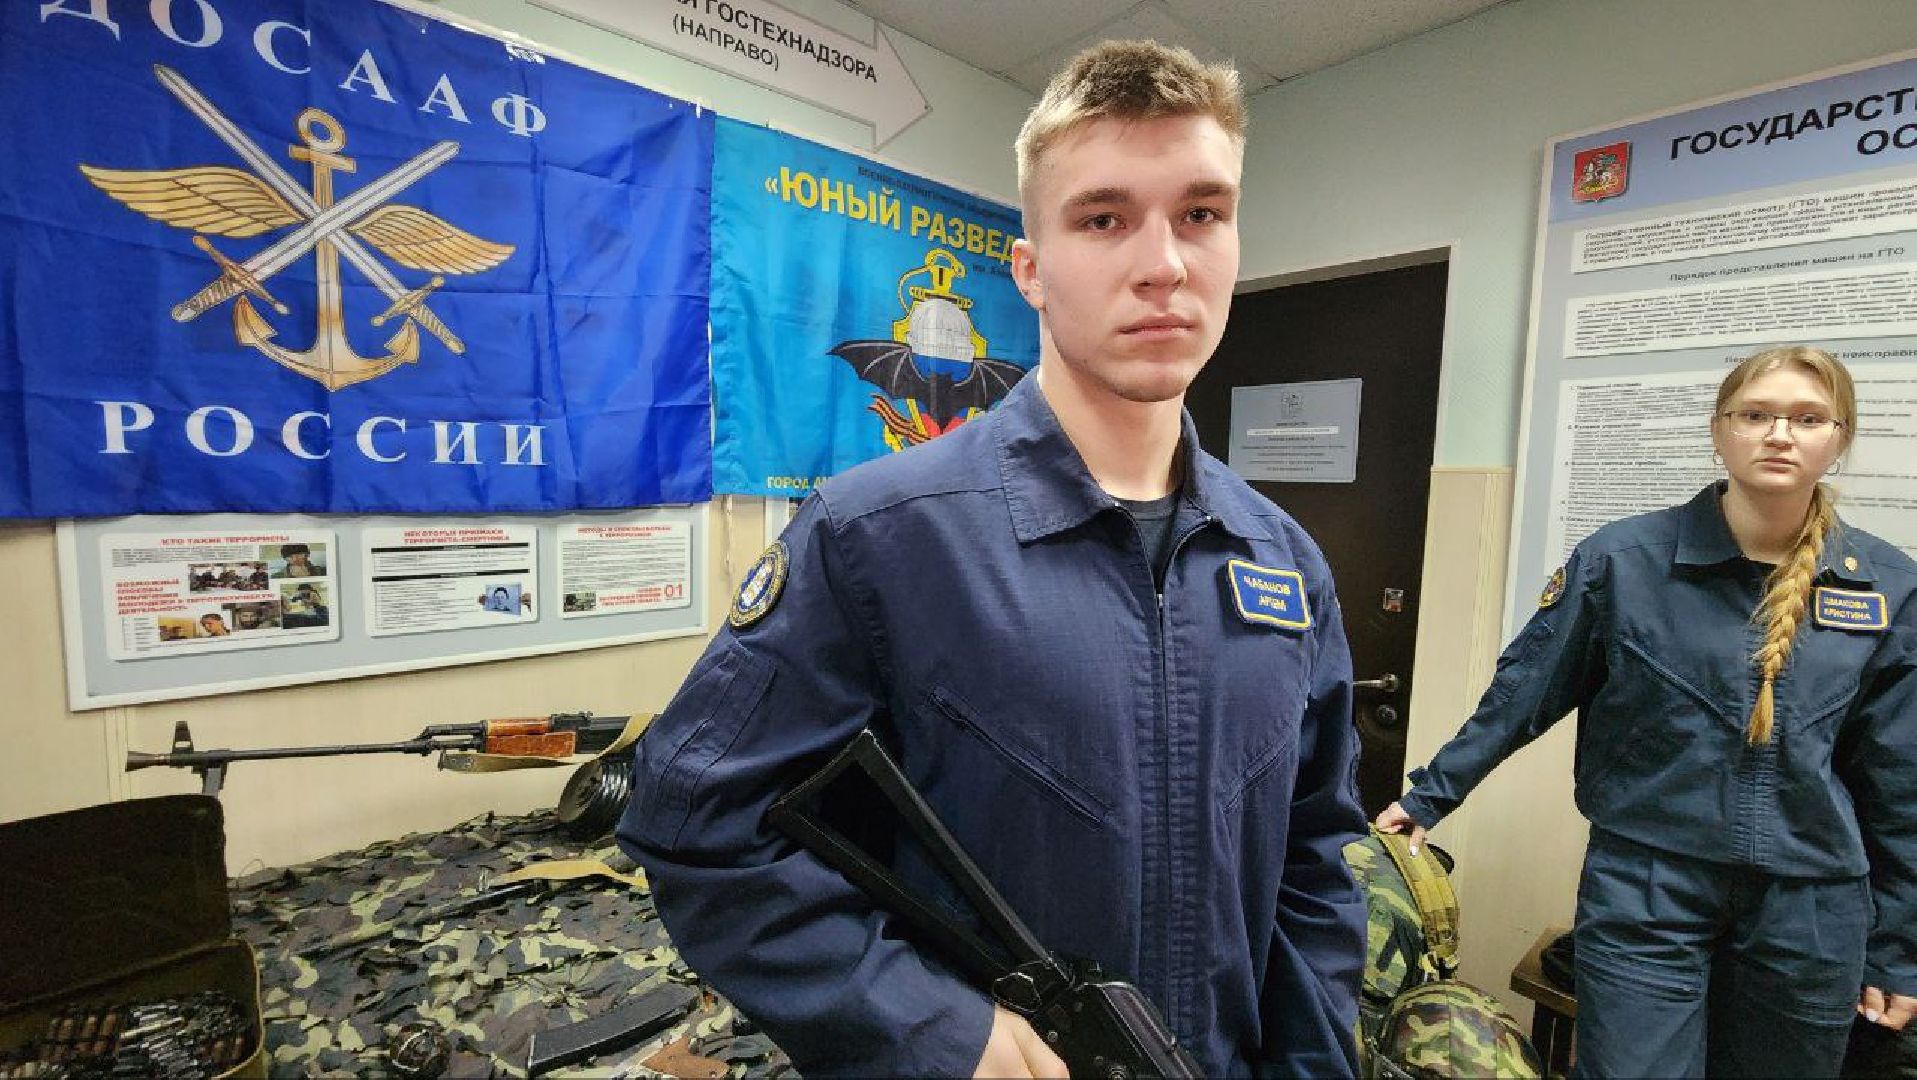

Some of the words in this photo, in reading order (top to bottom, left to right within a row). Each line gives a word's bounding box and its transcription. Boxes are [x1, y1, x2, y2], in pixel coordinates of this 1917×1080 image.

[673, 13, 779, 71] (НАПРАВО)
[705, 0, 878, 83] ГОСТЕХНАДЗОРА
[1669, 87, 1917, 161] ГОСУДАРСТ
[765, 167, 901, 230] «ЮНЫЙ
[1878, 247, 1905, 257] ГТО
[95, 400, 548, 467] РОССИИ
[225, 535, 290, 543] ТЕРРОРИСТЫ
[664, 584, 683, 597] 01
